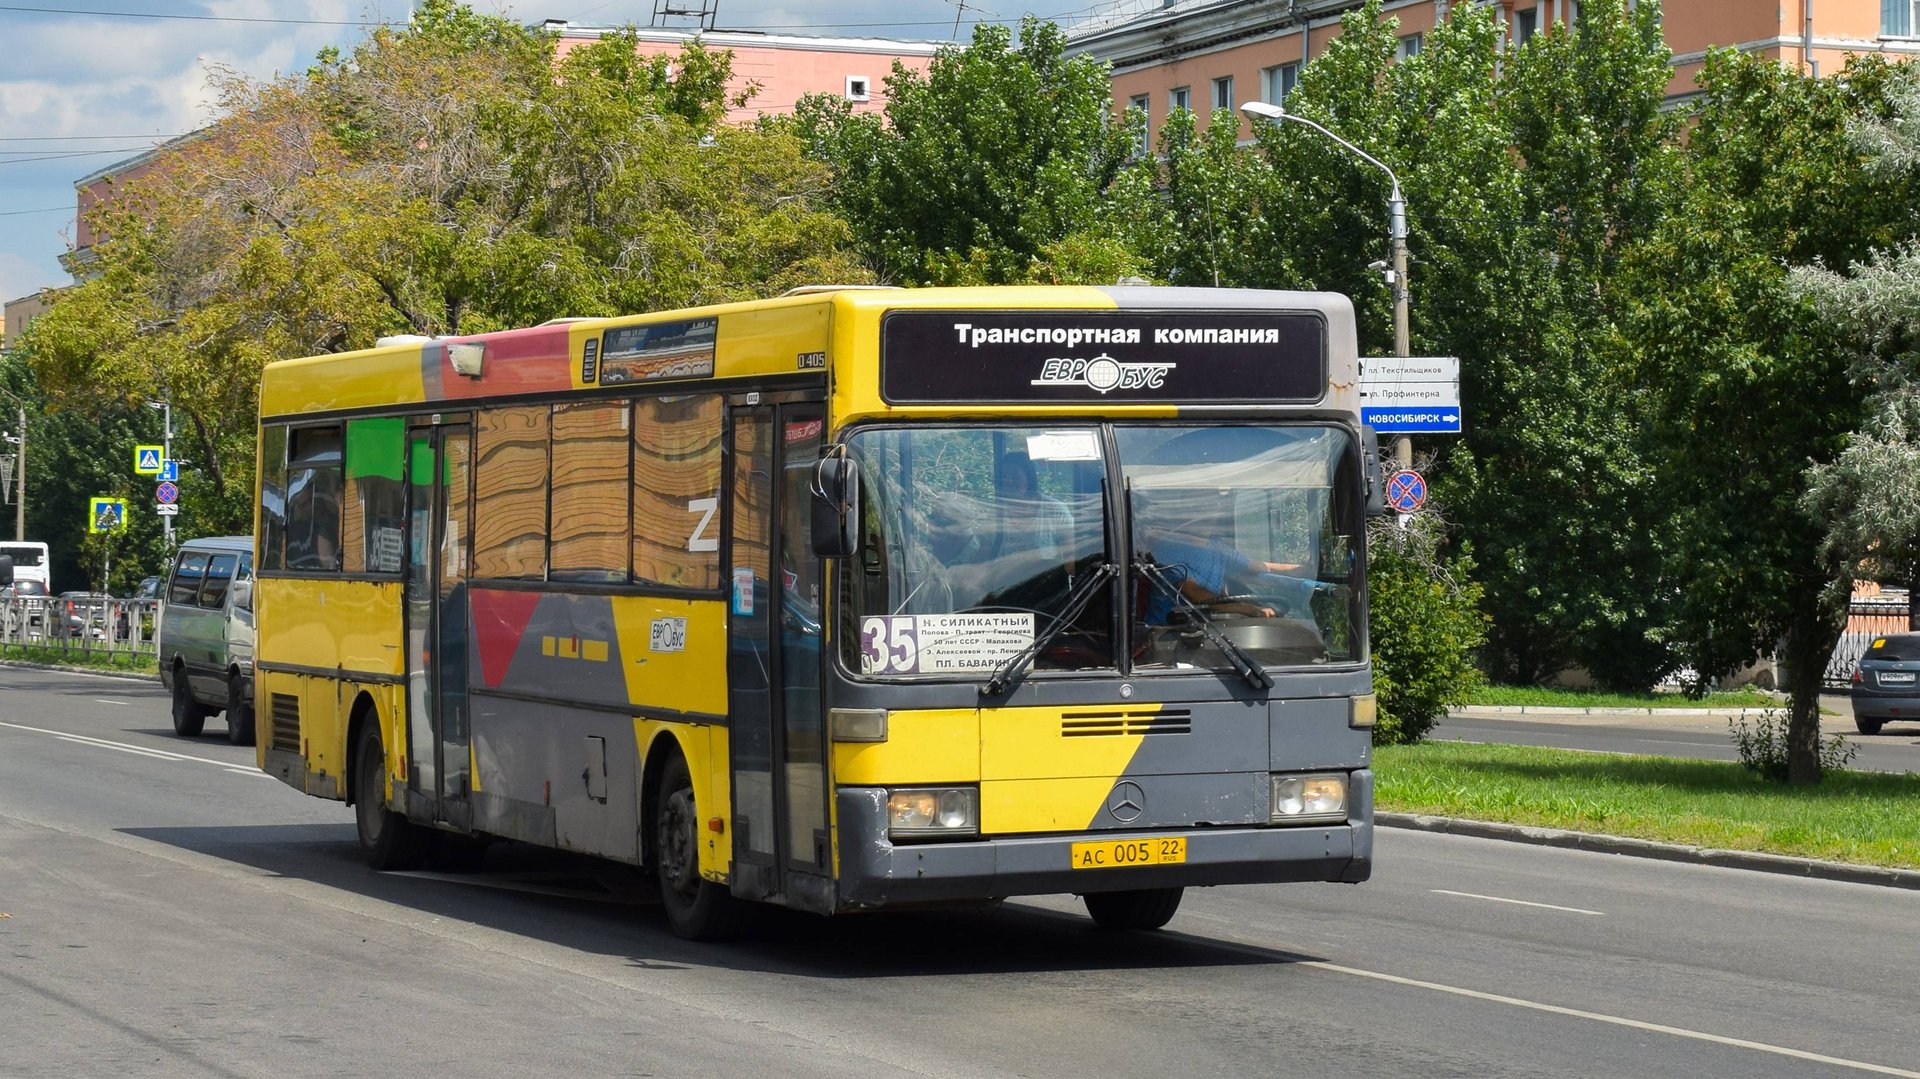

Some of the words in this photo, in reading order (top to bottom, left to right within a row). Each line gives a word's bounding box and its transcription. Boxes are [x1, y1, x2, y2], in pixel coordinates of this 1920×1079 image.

[953, 322, 1141, 348] Транспортная
[1154, 325, 1279, 343] компания
[806, 353, 825, 367] 405
[1381, 366, 1442, 375] Текстильщиков
[1369, 390, 1380, 399] ул.
[1382, 389, 1440, 400] Профинтерна
[1368, 414, 1440, 424] НОВОСИБИРСК
[687, 497, 719, 552] Z
[923, 619, 936, 627] Н.
[940, 616, 1029, 627] СИЛИКАТНЫЙ
[863, 617, 916, 672] 35
[936, 659, 955, 668] ПЛ.
[958, 659, 1010, 668] БАВАРИН
[1114, 842, 1150, 863] 005
[1161, 840, 1179, 855] 22
